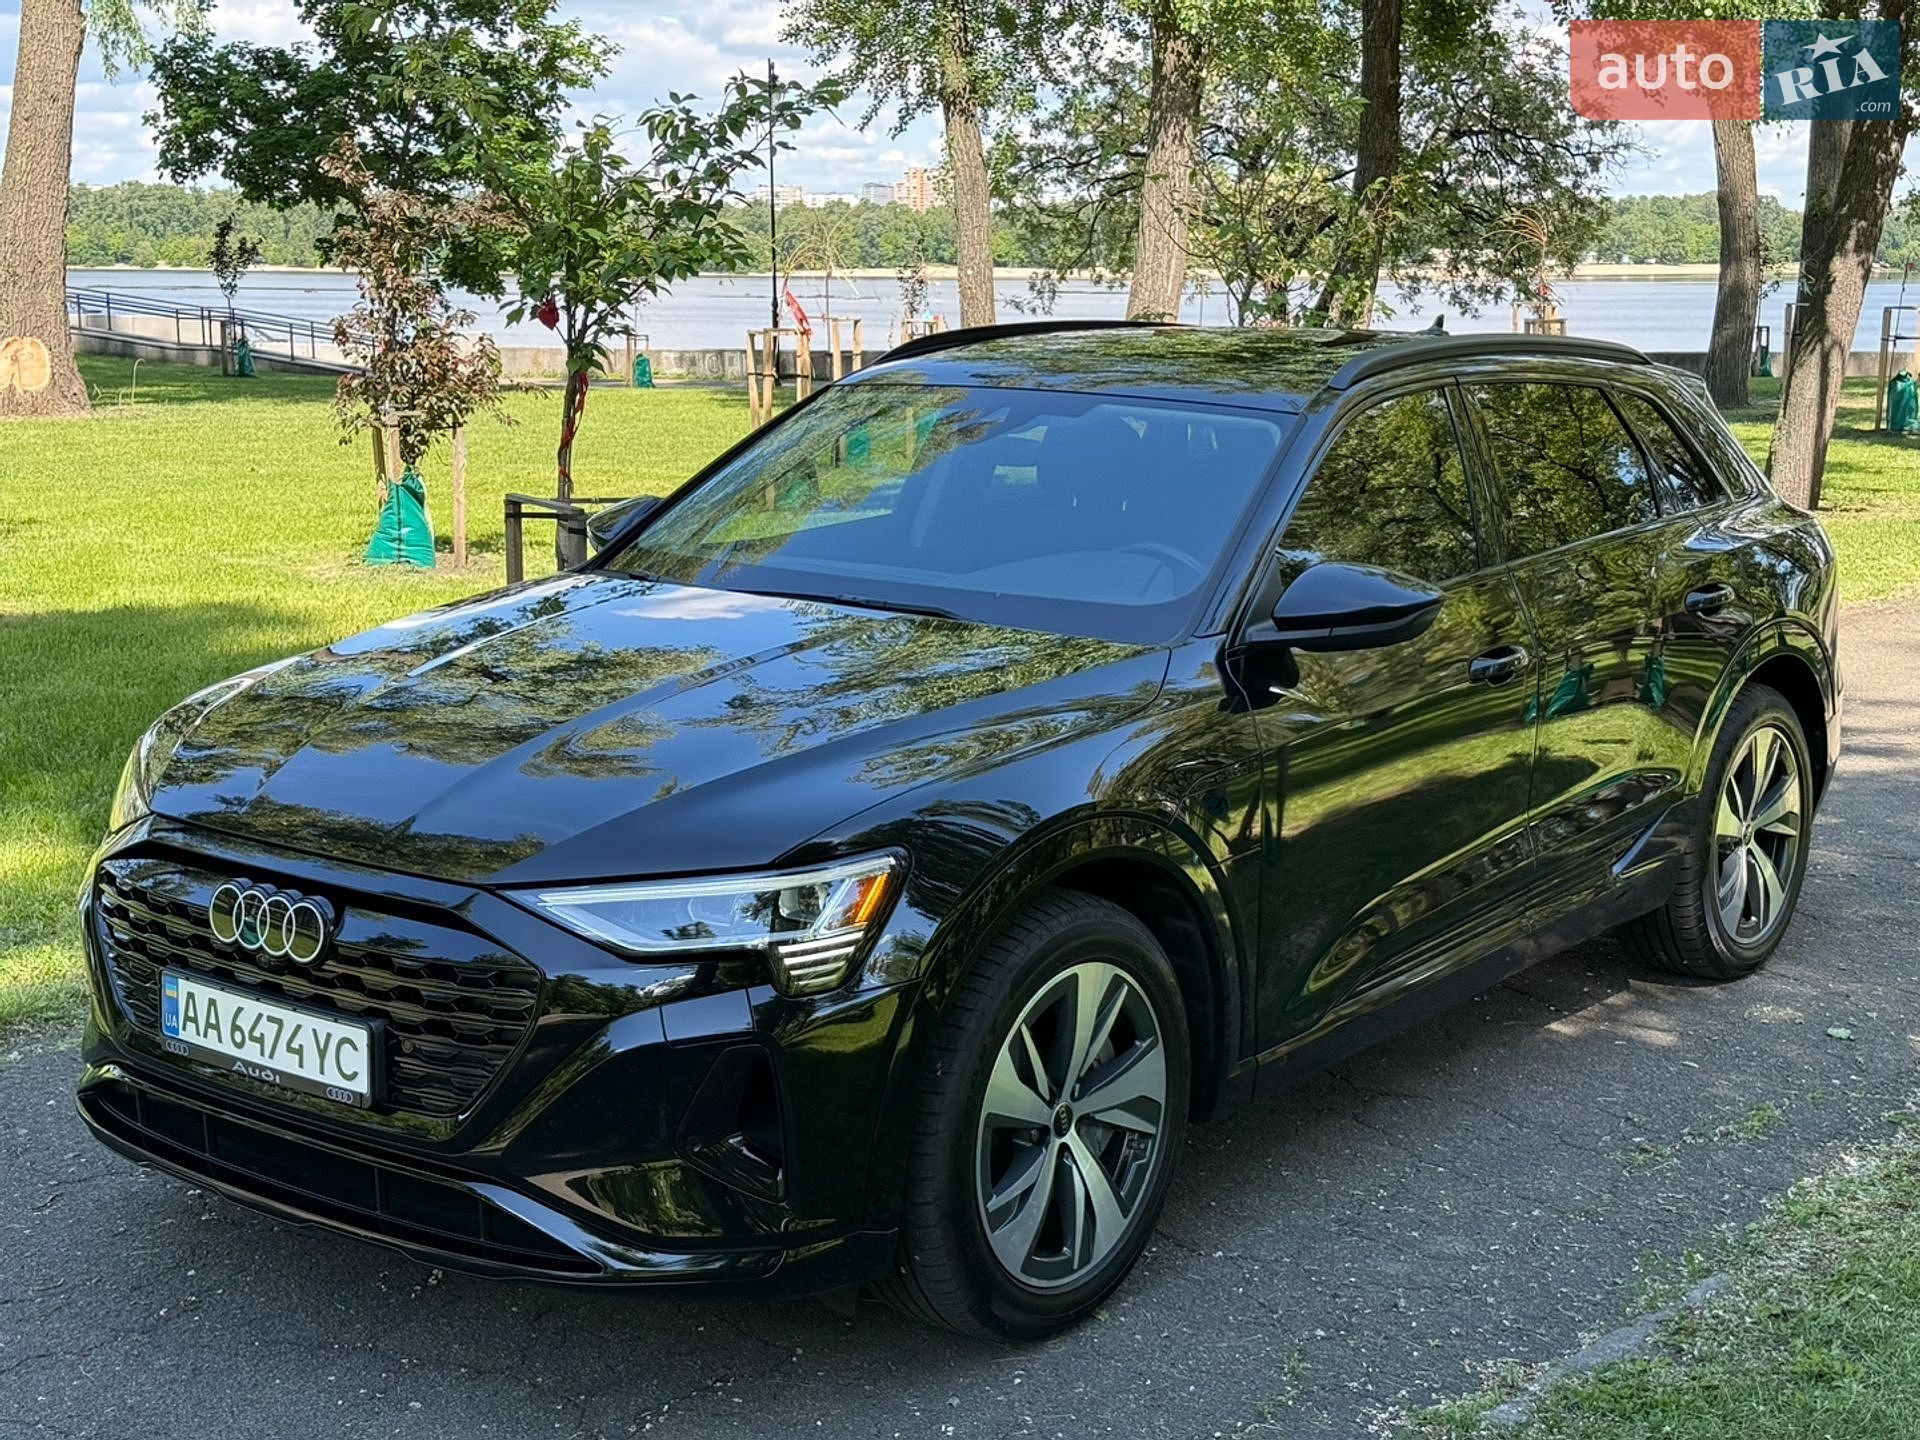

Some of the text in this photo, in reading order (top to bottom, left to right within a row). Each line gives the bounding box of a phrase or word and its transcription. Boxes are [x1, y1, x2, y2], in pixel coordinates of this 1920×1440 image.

[165, 1013, 178, 1028] UA
[181, 991, 359, 1082] AA 6474 YC
[232, 1061, 281, 1084] Audi
